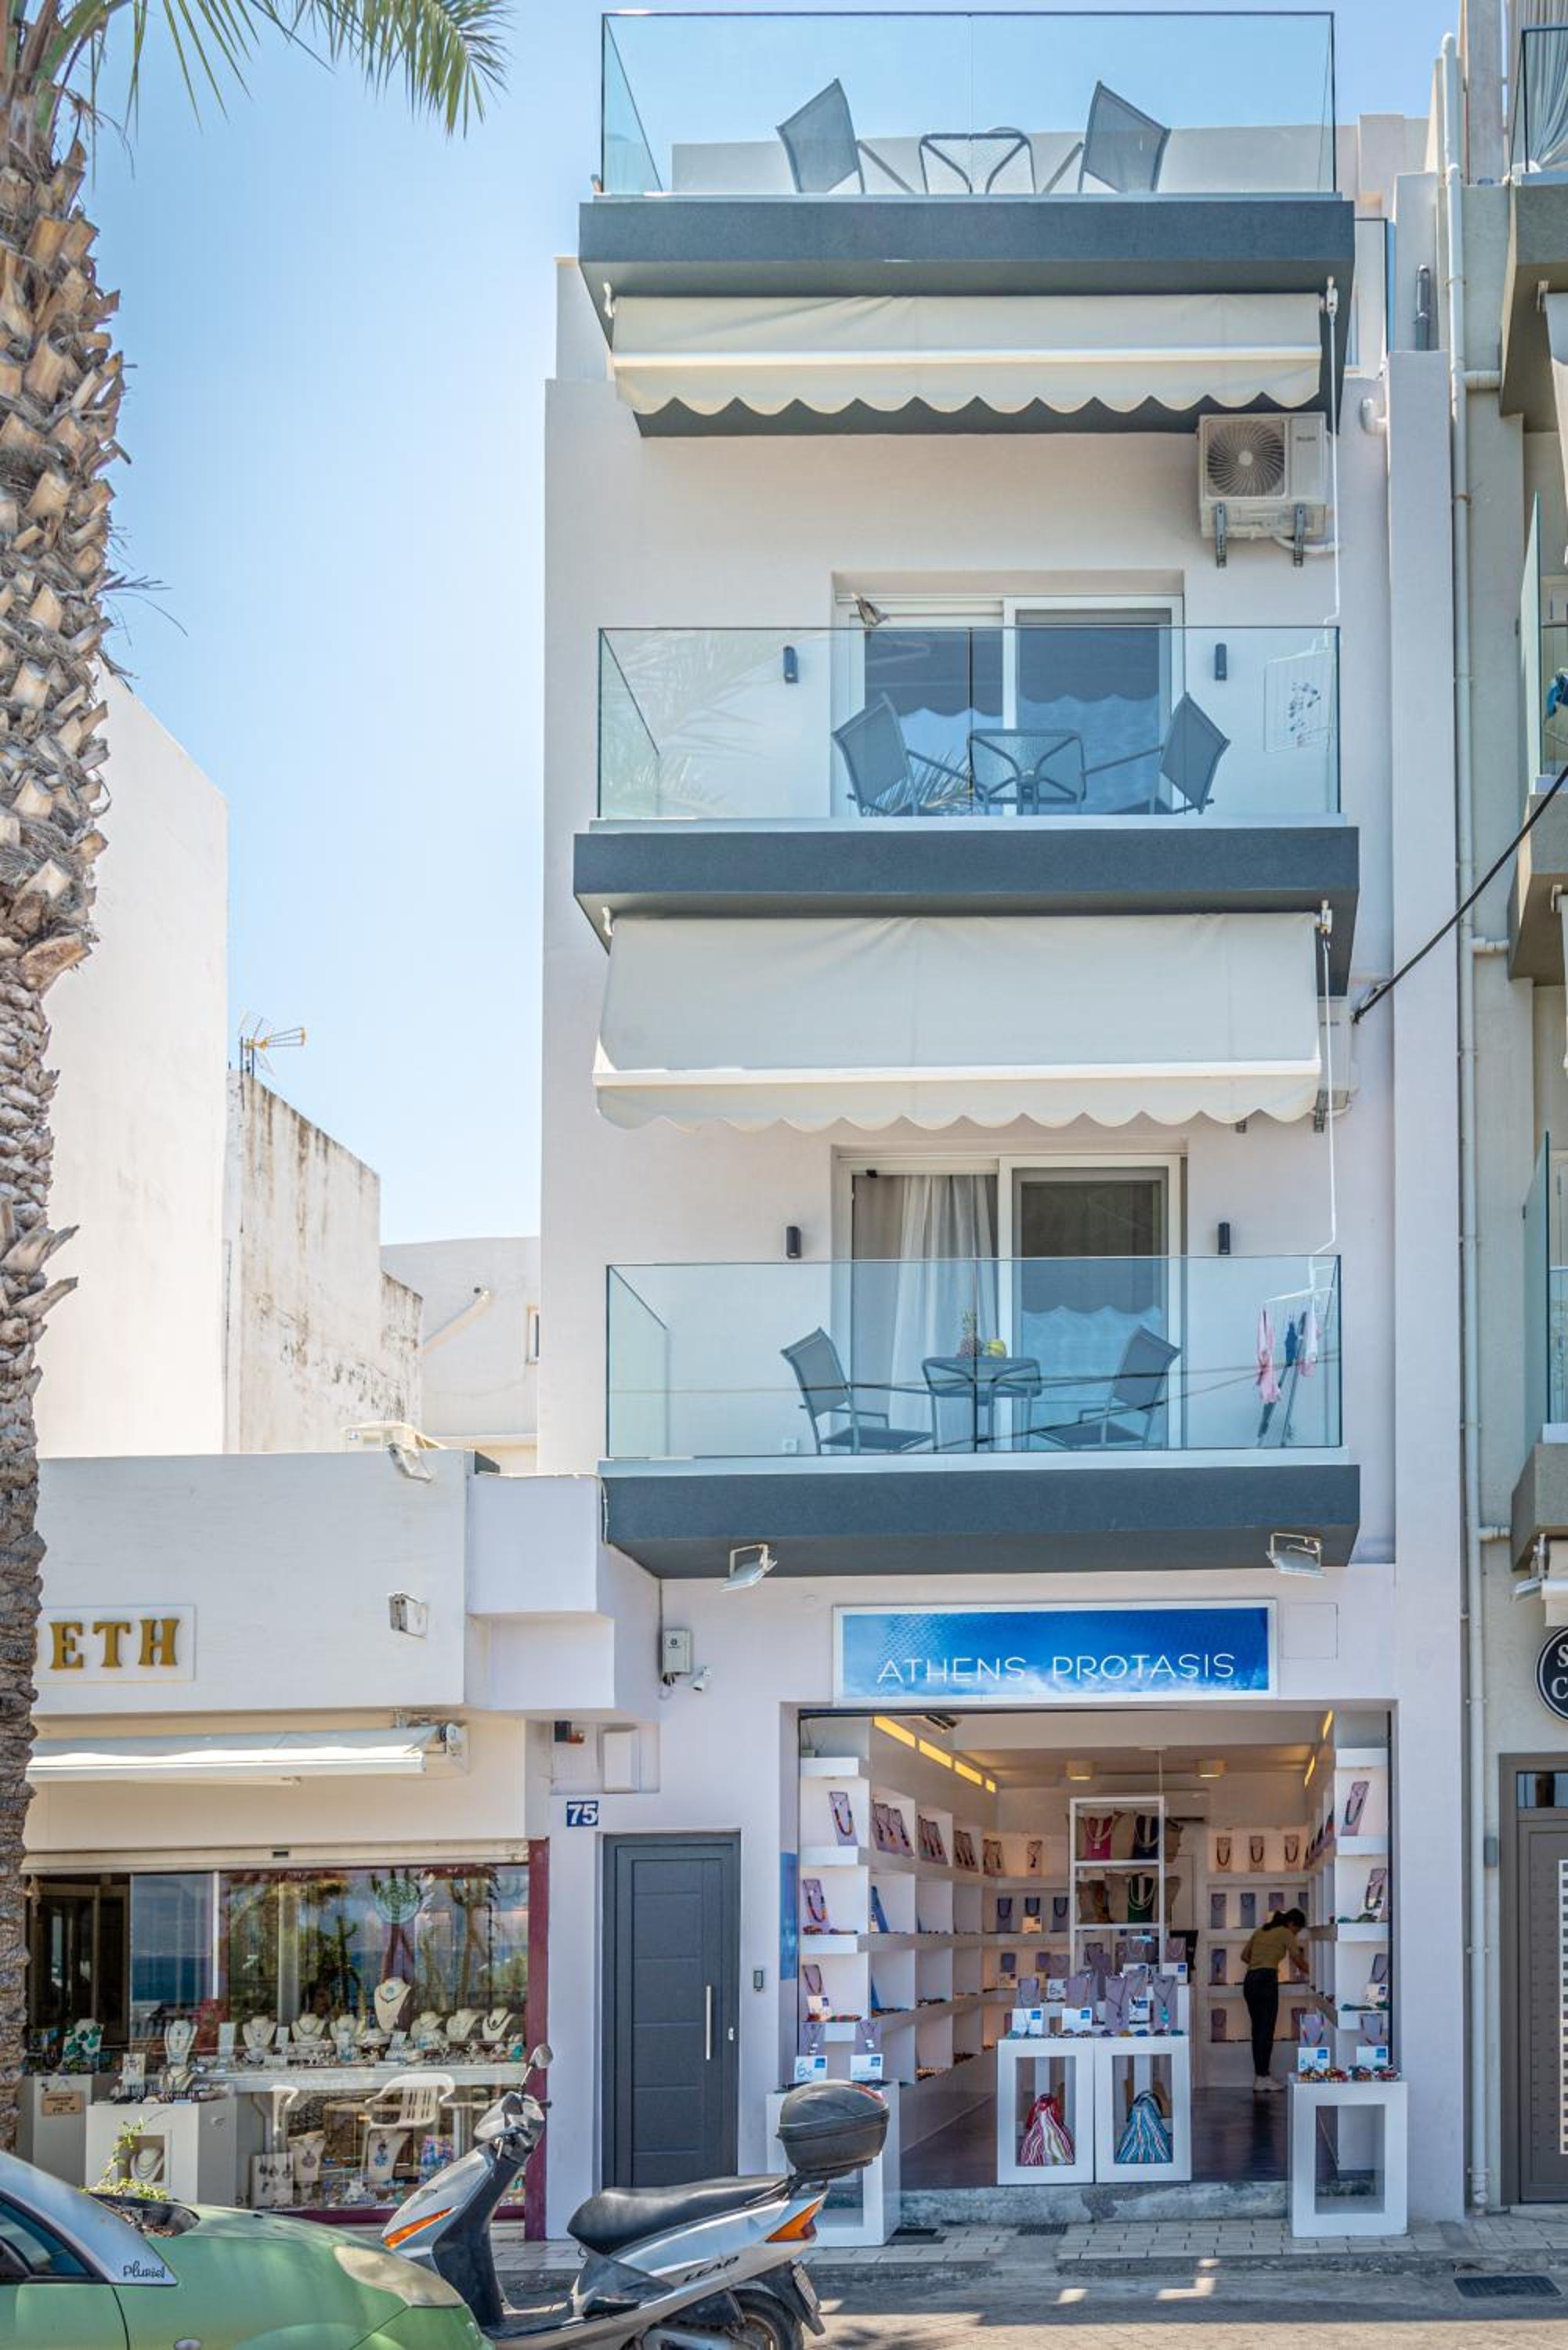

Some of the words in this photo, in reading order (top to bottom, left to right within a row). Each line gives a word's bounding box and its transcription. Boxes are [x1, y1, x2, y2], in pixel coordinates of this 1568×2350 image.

[48, 1618, 181, 1670] ETH
[876, 1656, 1028, 1683] ATHENS
[1052, 1653, 1236, 1680] PROTASIS
[567, 1803, 598, 1825] 75
